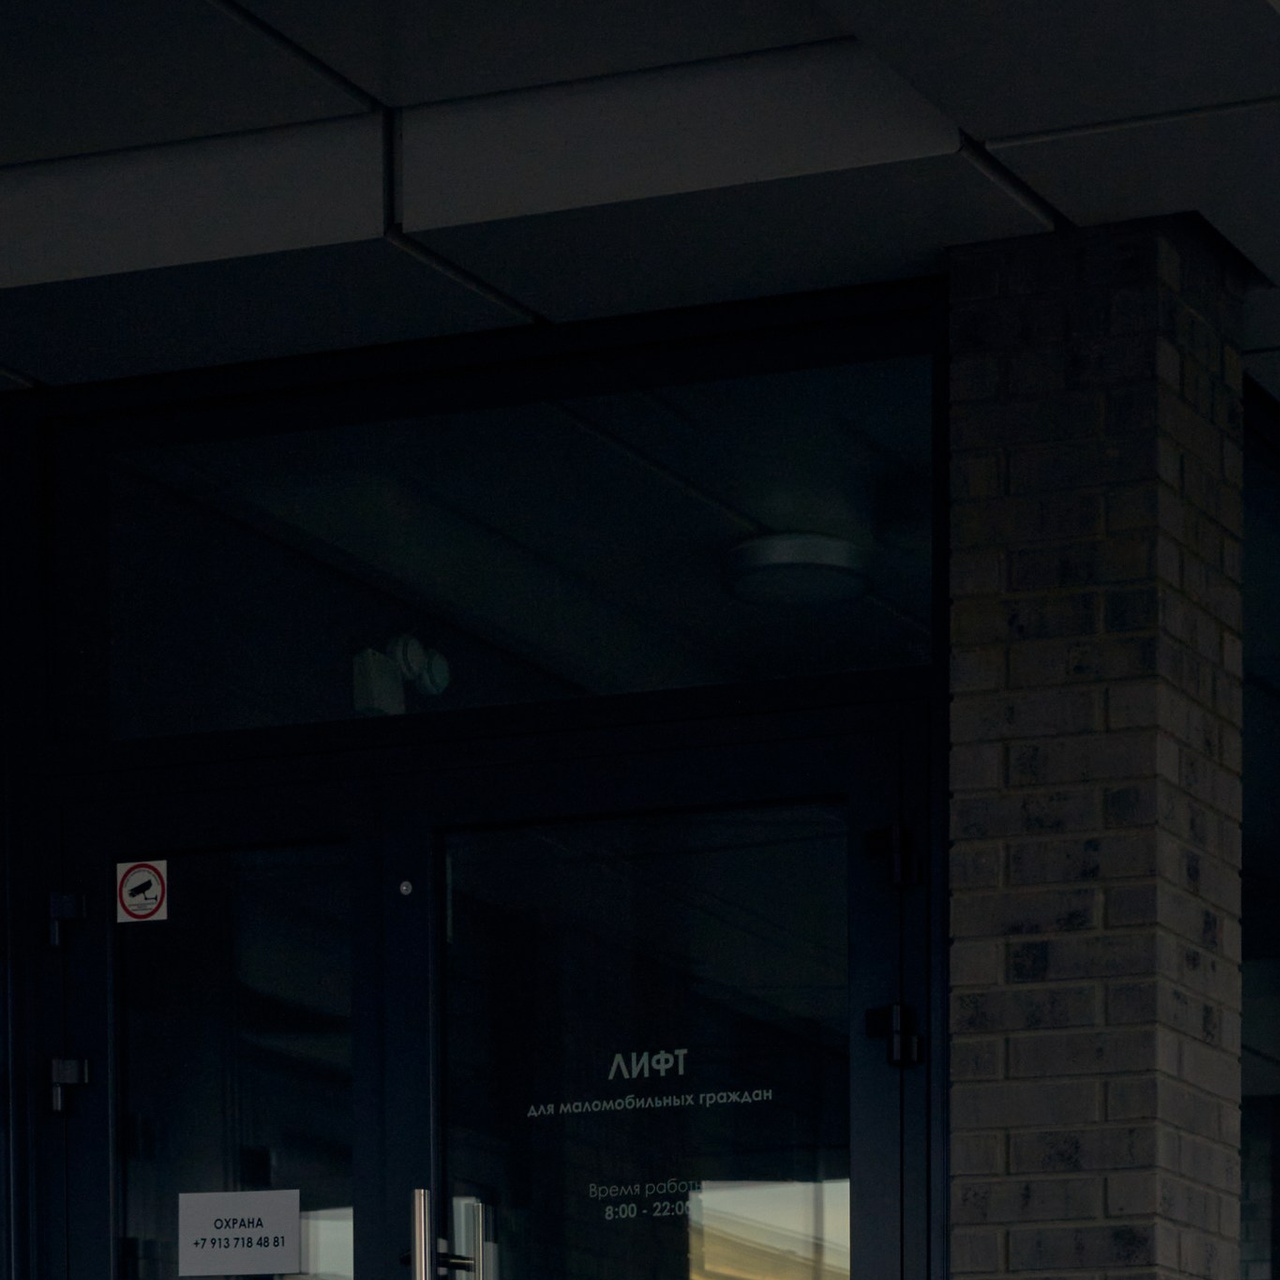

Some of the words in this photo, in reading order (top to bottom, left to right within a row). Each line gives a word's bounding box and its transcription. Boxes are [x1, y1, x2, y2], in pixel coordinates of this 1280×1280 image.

[608, 1048, 688, 1080] ЛИФТ
[527, 1103, 554, 1118] для
[559, 1094, 694, 1115] маломобильных
[700, 1088, 773, 1107] граждан
[589, 1183, 641, 1200] Время
[605, 1203, 638, 1220] 8:00
[213, 1217, 264, 1230] ОХРАНА
[193, 1238, 207, 1249] +7
[211, 1237, 230, 1249] 913
[234, 1237, 253, 1248] 718
[256, 1237, 269, 1248] 48
[273, 1236, 285, 1247] 81
